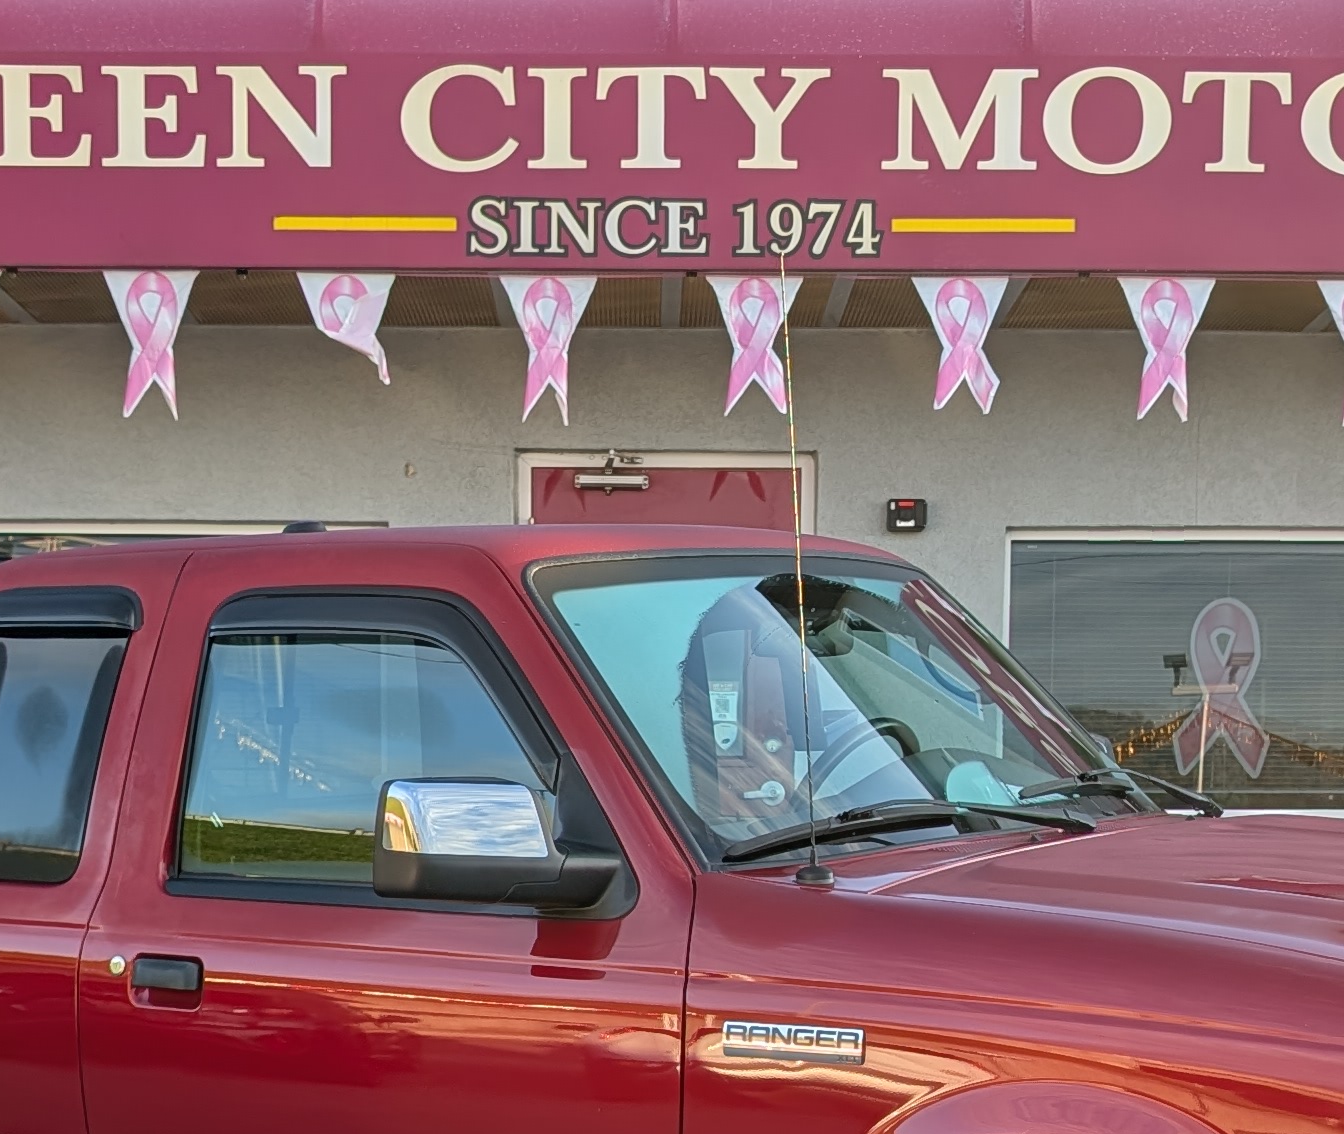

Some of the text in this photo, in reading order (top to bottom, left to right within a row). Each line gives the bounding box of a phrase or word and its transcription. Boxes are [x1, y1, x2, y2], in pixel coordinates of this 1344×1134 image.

[399, 65, 830, 173] CITY
[467, 197, 883, 259] SINCE 1974
[725, 1024, 860, 1049] RANGER
